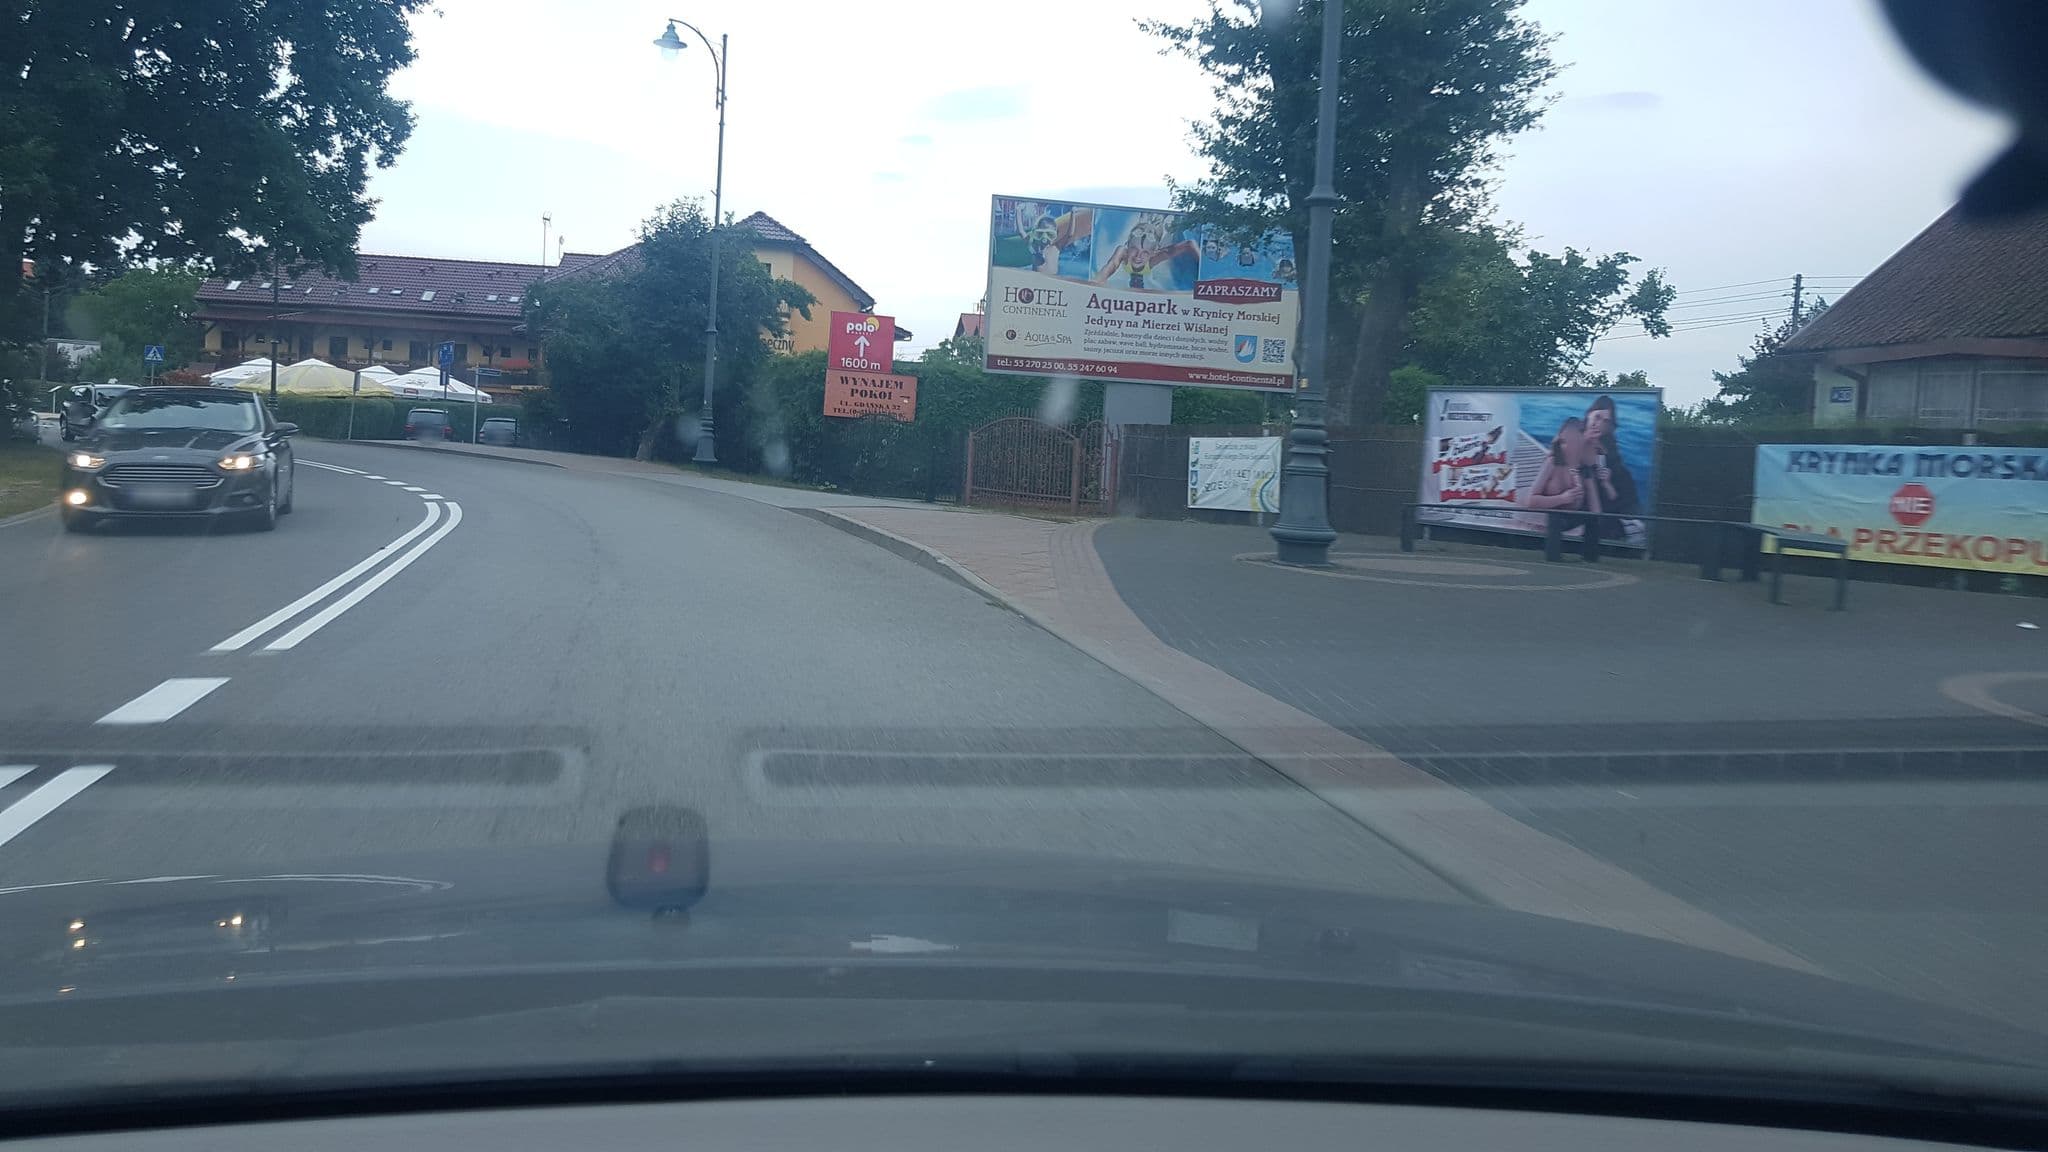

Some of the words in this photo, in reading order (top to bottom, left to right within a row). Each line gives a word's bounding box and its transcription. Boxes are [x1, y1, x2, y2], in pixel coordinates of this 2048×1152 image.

[1004, 286, 1068, 307] HOTEL
[1198, 284, 1278, 297] ZAPRASZAMY
[1003, 305, 1068, 318] CONTINENTAL
[1086, 293, 1178, 317] Aquapark
[1193, 307, 1234, 321] Krynicy
[1236, 310, 1281, 325] Morskiej
[846, 321, 875, 334] polo
[1085, 315, 1123, 329] Jedyny
[1126, 319, 1138, 328] na
[1142, 319, 1180, 331] Mierzei
[1184, 322, 1229, 336] Wiślanej
[1023, 331, 1050, 343] AQUA
[1056, 334, 1072, 344] SPA
[840, 357, 868, 369] 1600
[870, 361, 881, 370] m
[1013, 360, 1024, 368] 55
[1025, 360, 1041, 369] 270
[1042, 361, 1053, 370] 25
[1067, 363, 1078, 371] 55
[1079, 364, 1094, 373] 247
[1095, 365, 1106, 373] 60
[1107, 366, 1118, 374] 94
[840, 376, 904, 390] WYNAJEM
[1188, 371, 1285, 386] www.hotel-continental.pl
[850, 388, 892, 400] POKOI
[1788, 450, 1902, 476] KRYNICA
[1915, 453, 2048, 481] MORSK
[1892, 496, 1932, 515] NIE
